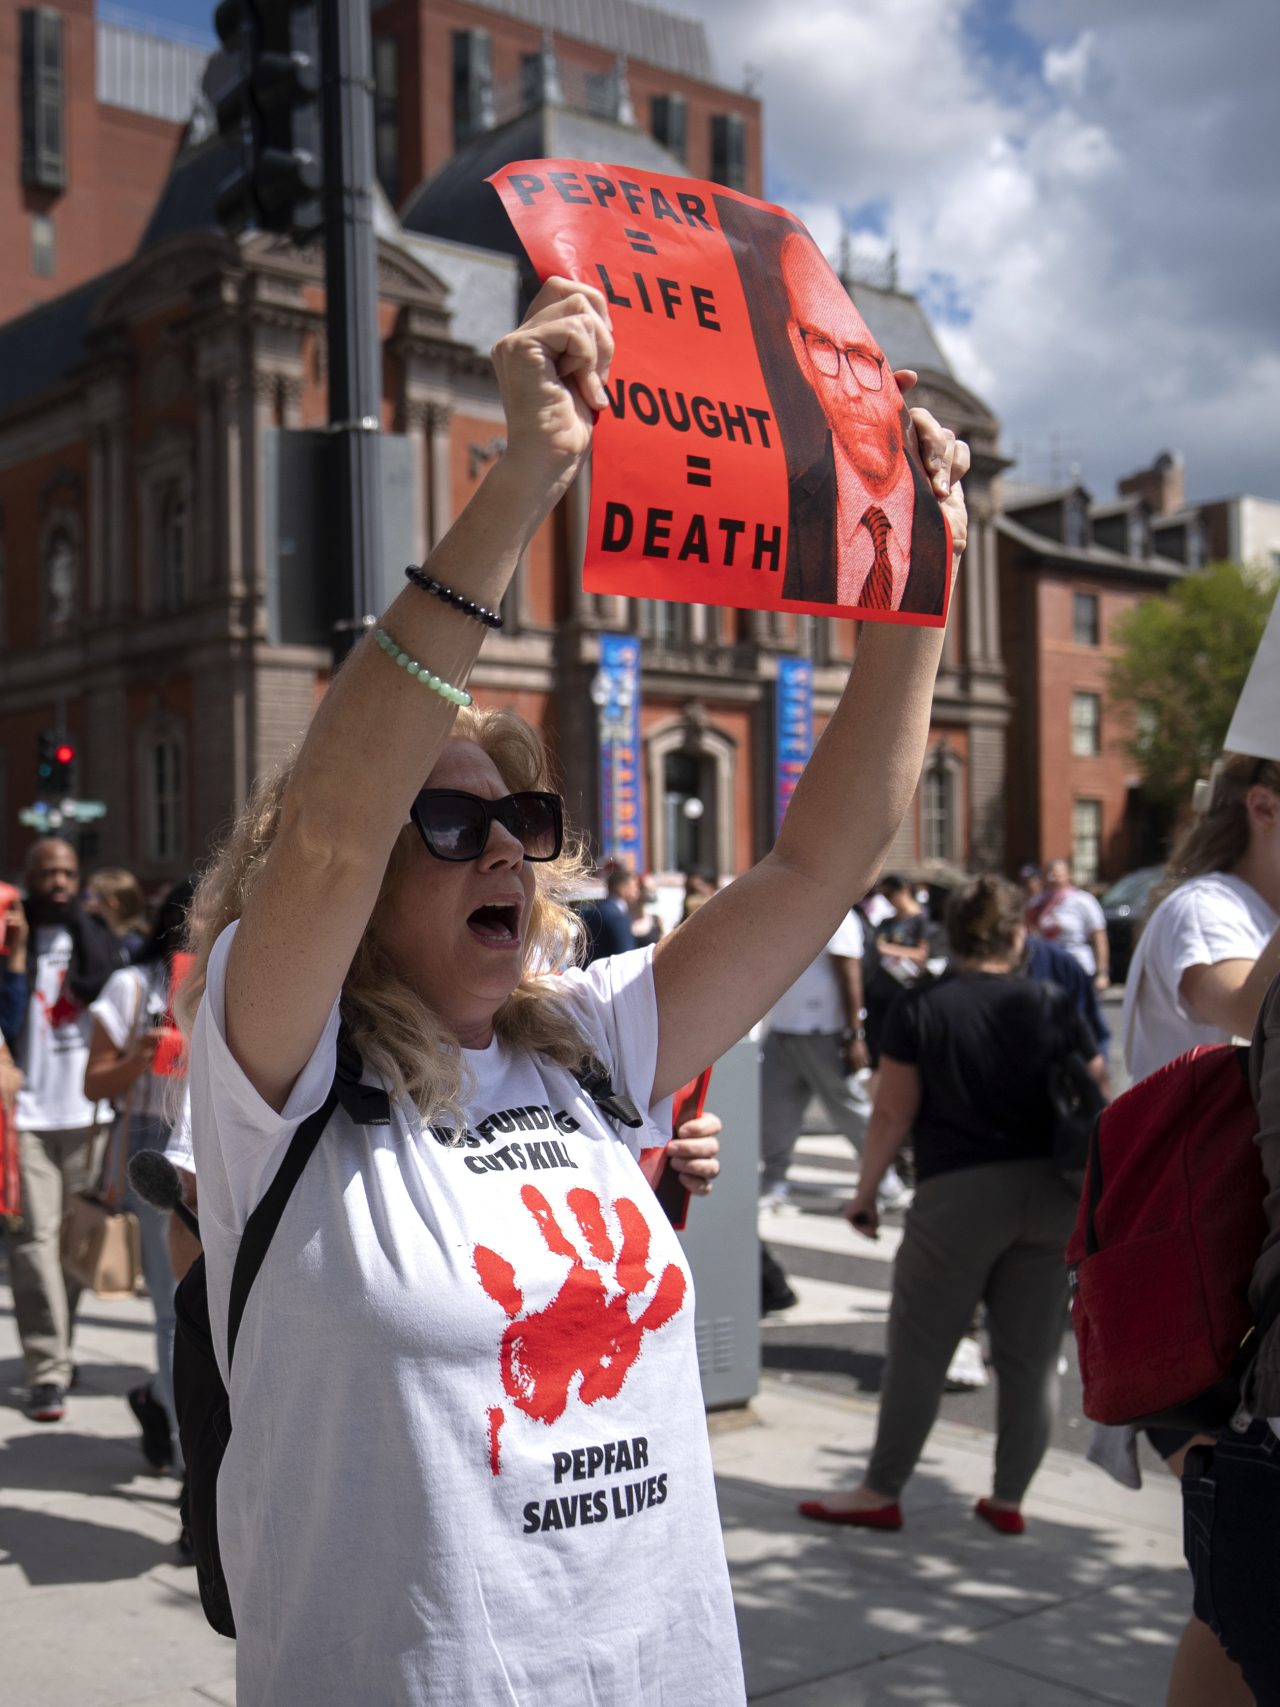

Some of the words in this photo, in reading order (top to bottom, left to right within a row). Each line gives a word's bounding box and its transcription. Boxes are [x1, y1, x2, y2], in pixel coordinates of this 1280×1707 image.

[507, 171, 715, 232] PEPFAR
[595, 263, 722, 333] LIFE
[603, 378, 771, 449] VOUGHT
[601, 501, 782, 572] DEATH
[475, 1104, 581, 1145] FUNDIG
[463, 1142, 528, 1175] CUTS
[552, 1436, 649, 1485] PEPFAR
[522, 1489, 609, 1535] SAVES
[611, 1473, 668, 1520] LIVES
